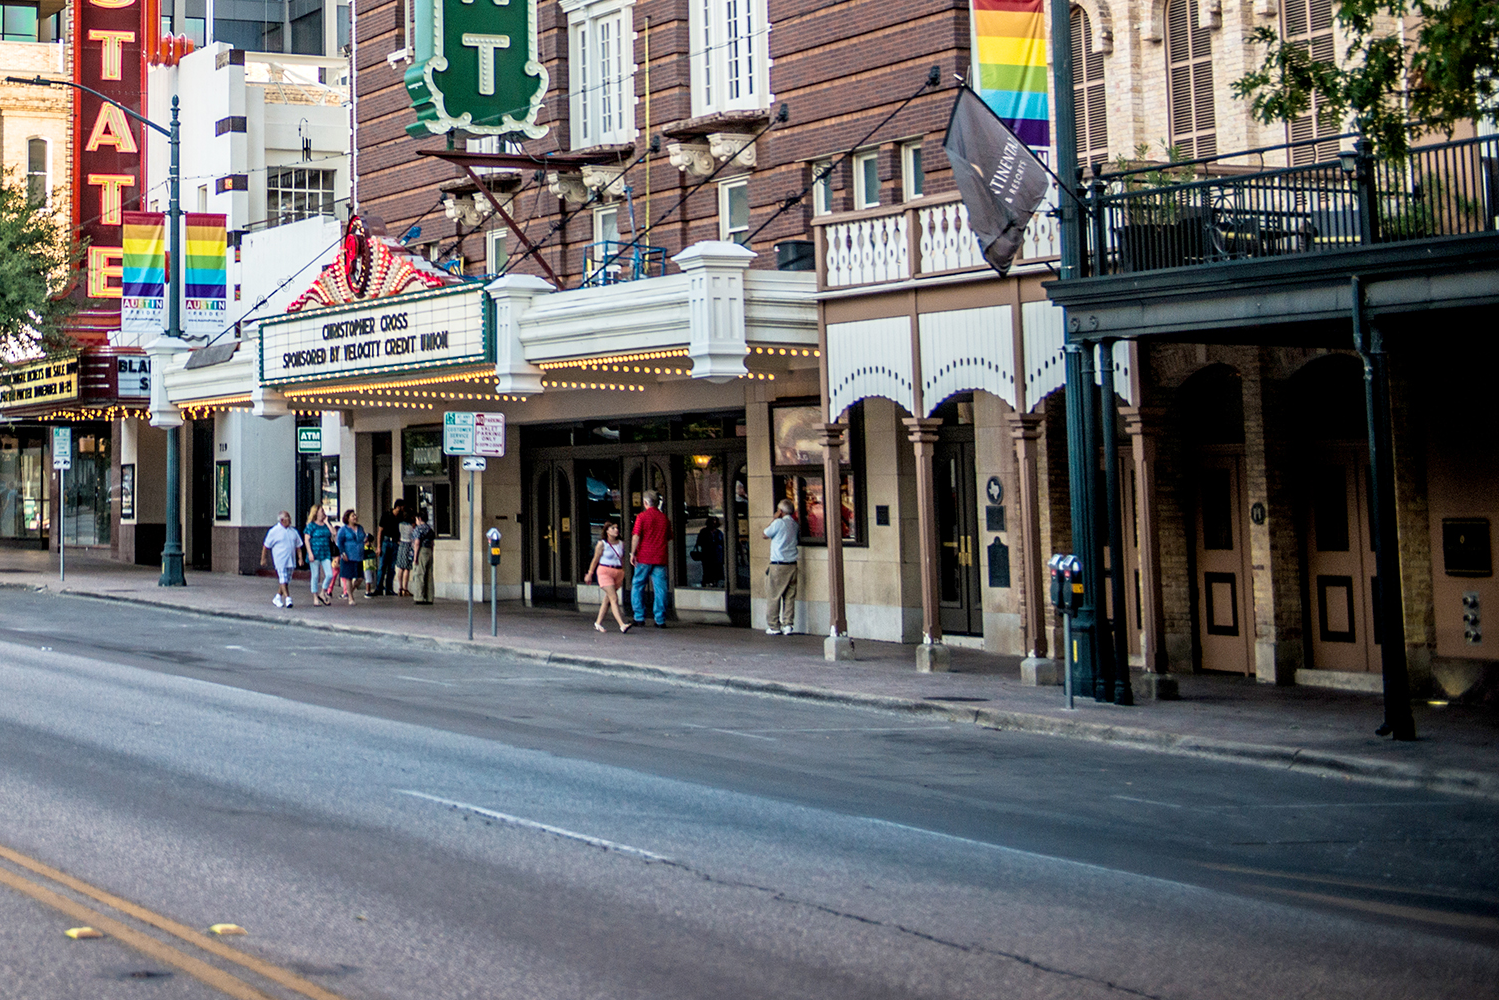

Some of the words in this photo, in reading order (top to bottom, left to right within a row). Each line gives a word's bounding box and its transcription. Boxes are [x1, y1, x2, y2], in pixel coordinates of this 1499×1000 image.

[1008, 160, 1027, 195] RESORTS
[123, 298, 164, 309] AUSTIN
[186, 300, 226, 310] AUSTIN
[322, 316, 375, 341] CHRISTOPHER
[380, 312, 408, 332] CROSS
[282, 348, 326, 369] SPONSORED
[329, 344, 341, 363] BY
[344, 339, 381, 361] VELOCITY
[384, 335, 417, 356] CREDIT
[420, 330, 449, 351] UNION
[53, 363, 65, 377] SALE
[300, 431, 321, 440] ATM
